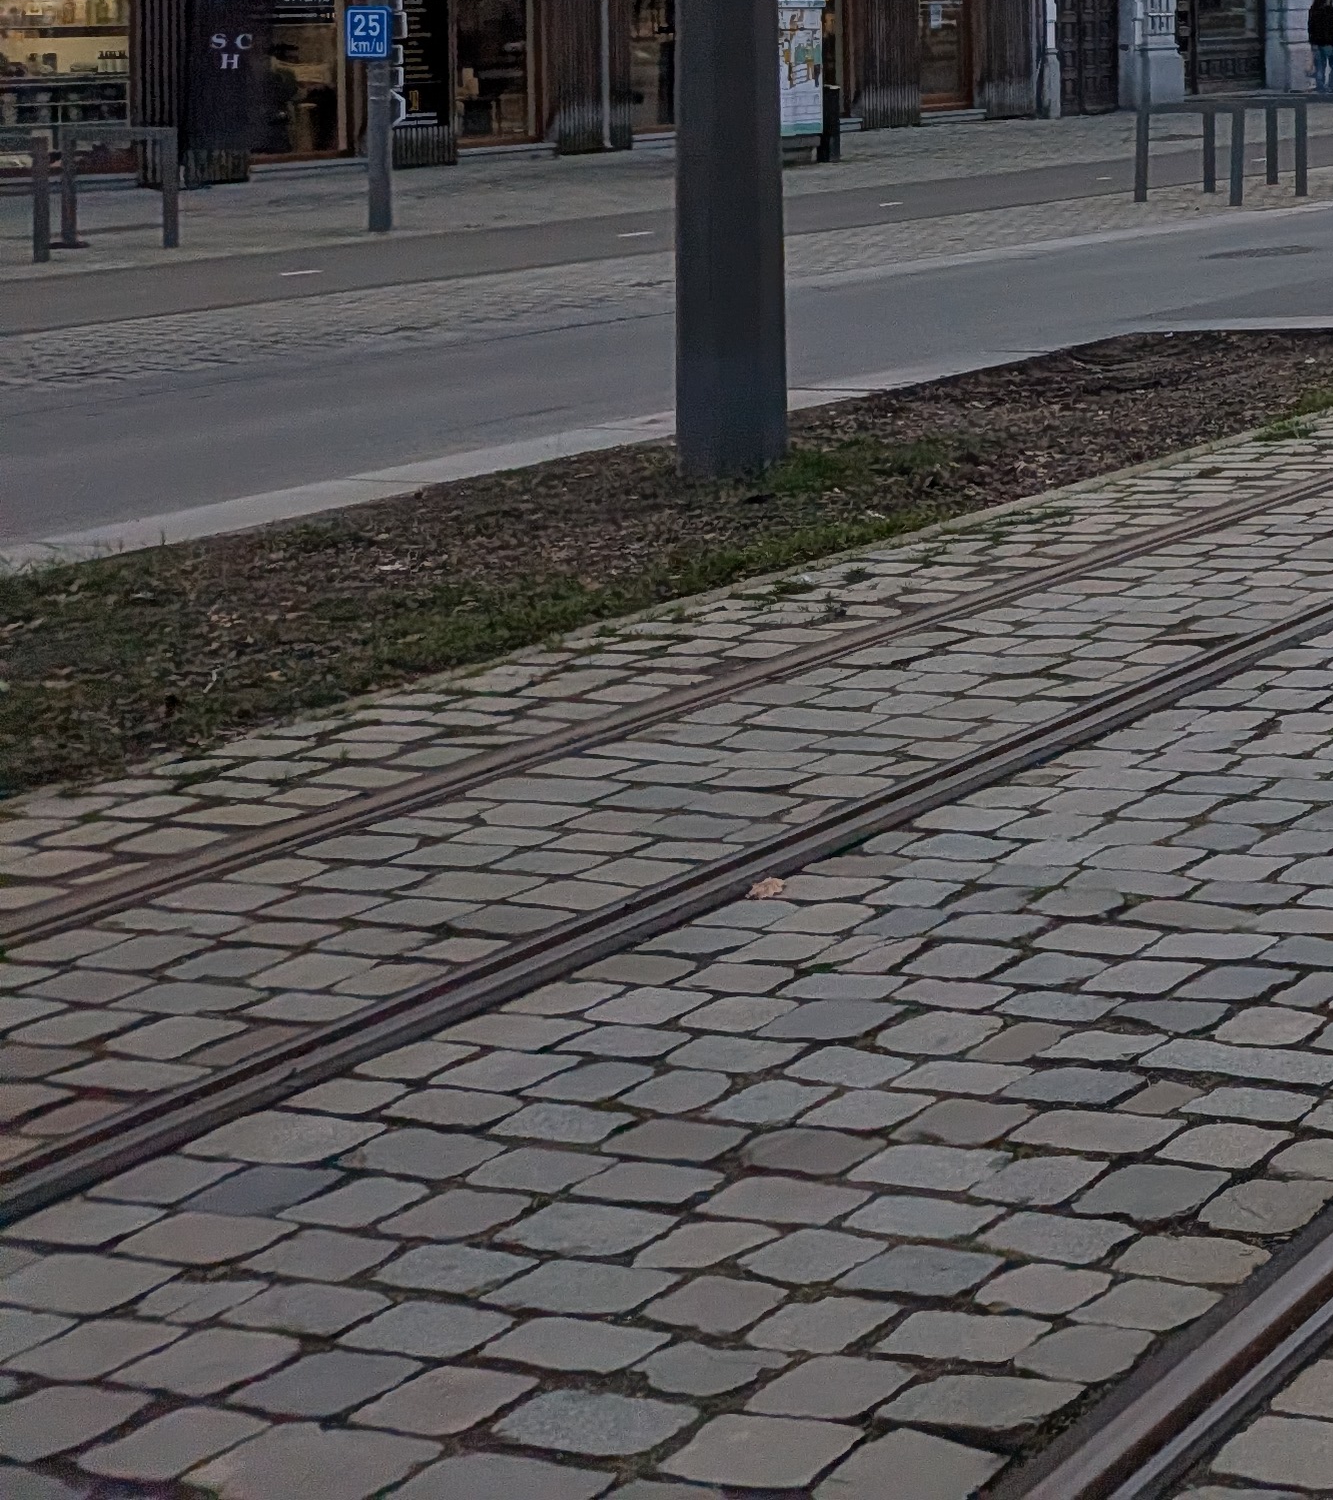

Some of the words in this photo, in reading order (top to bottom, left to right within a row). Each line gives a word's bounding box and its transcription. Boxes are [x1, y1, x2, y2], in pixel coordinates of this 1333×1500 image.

[353, 14, 381, 37] 25
[351, 38, 384, 53] km/u
[220, 53, 240, 70] H
